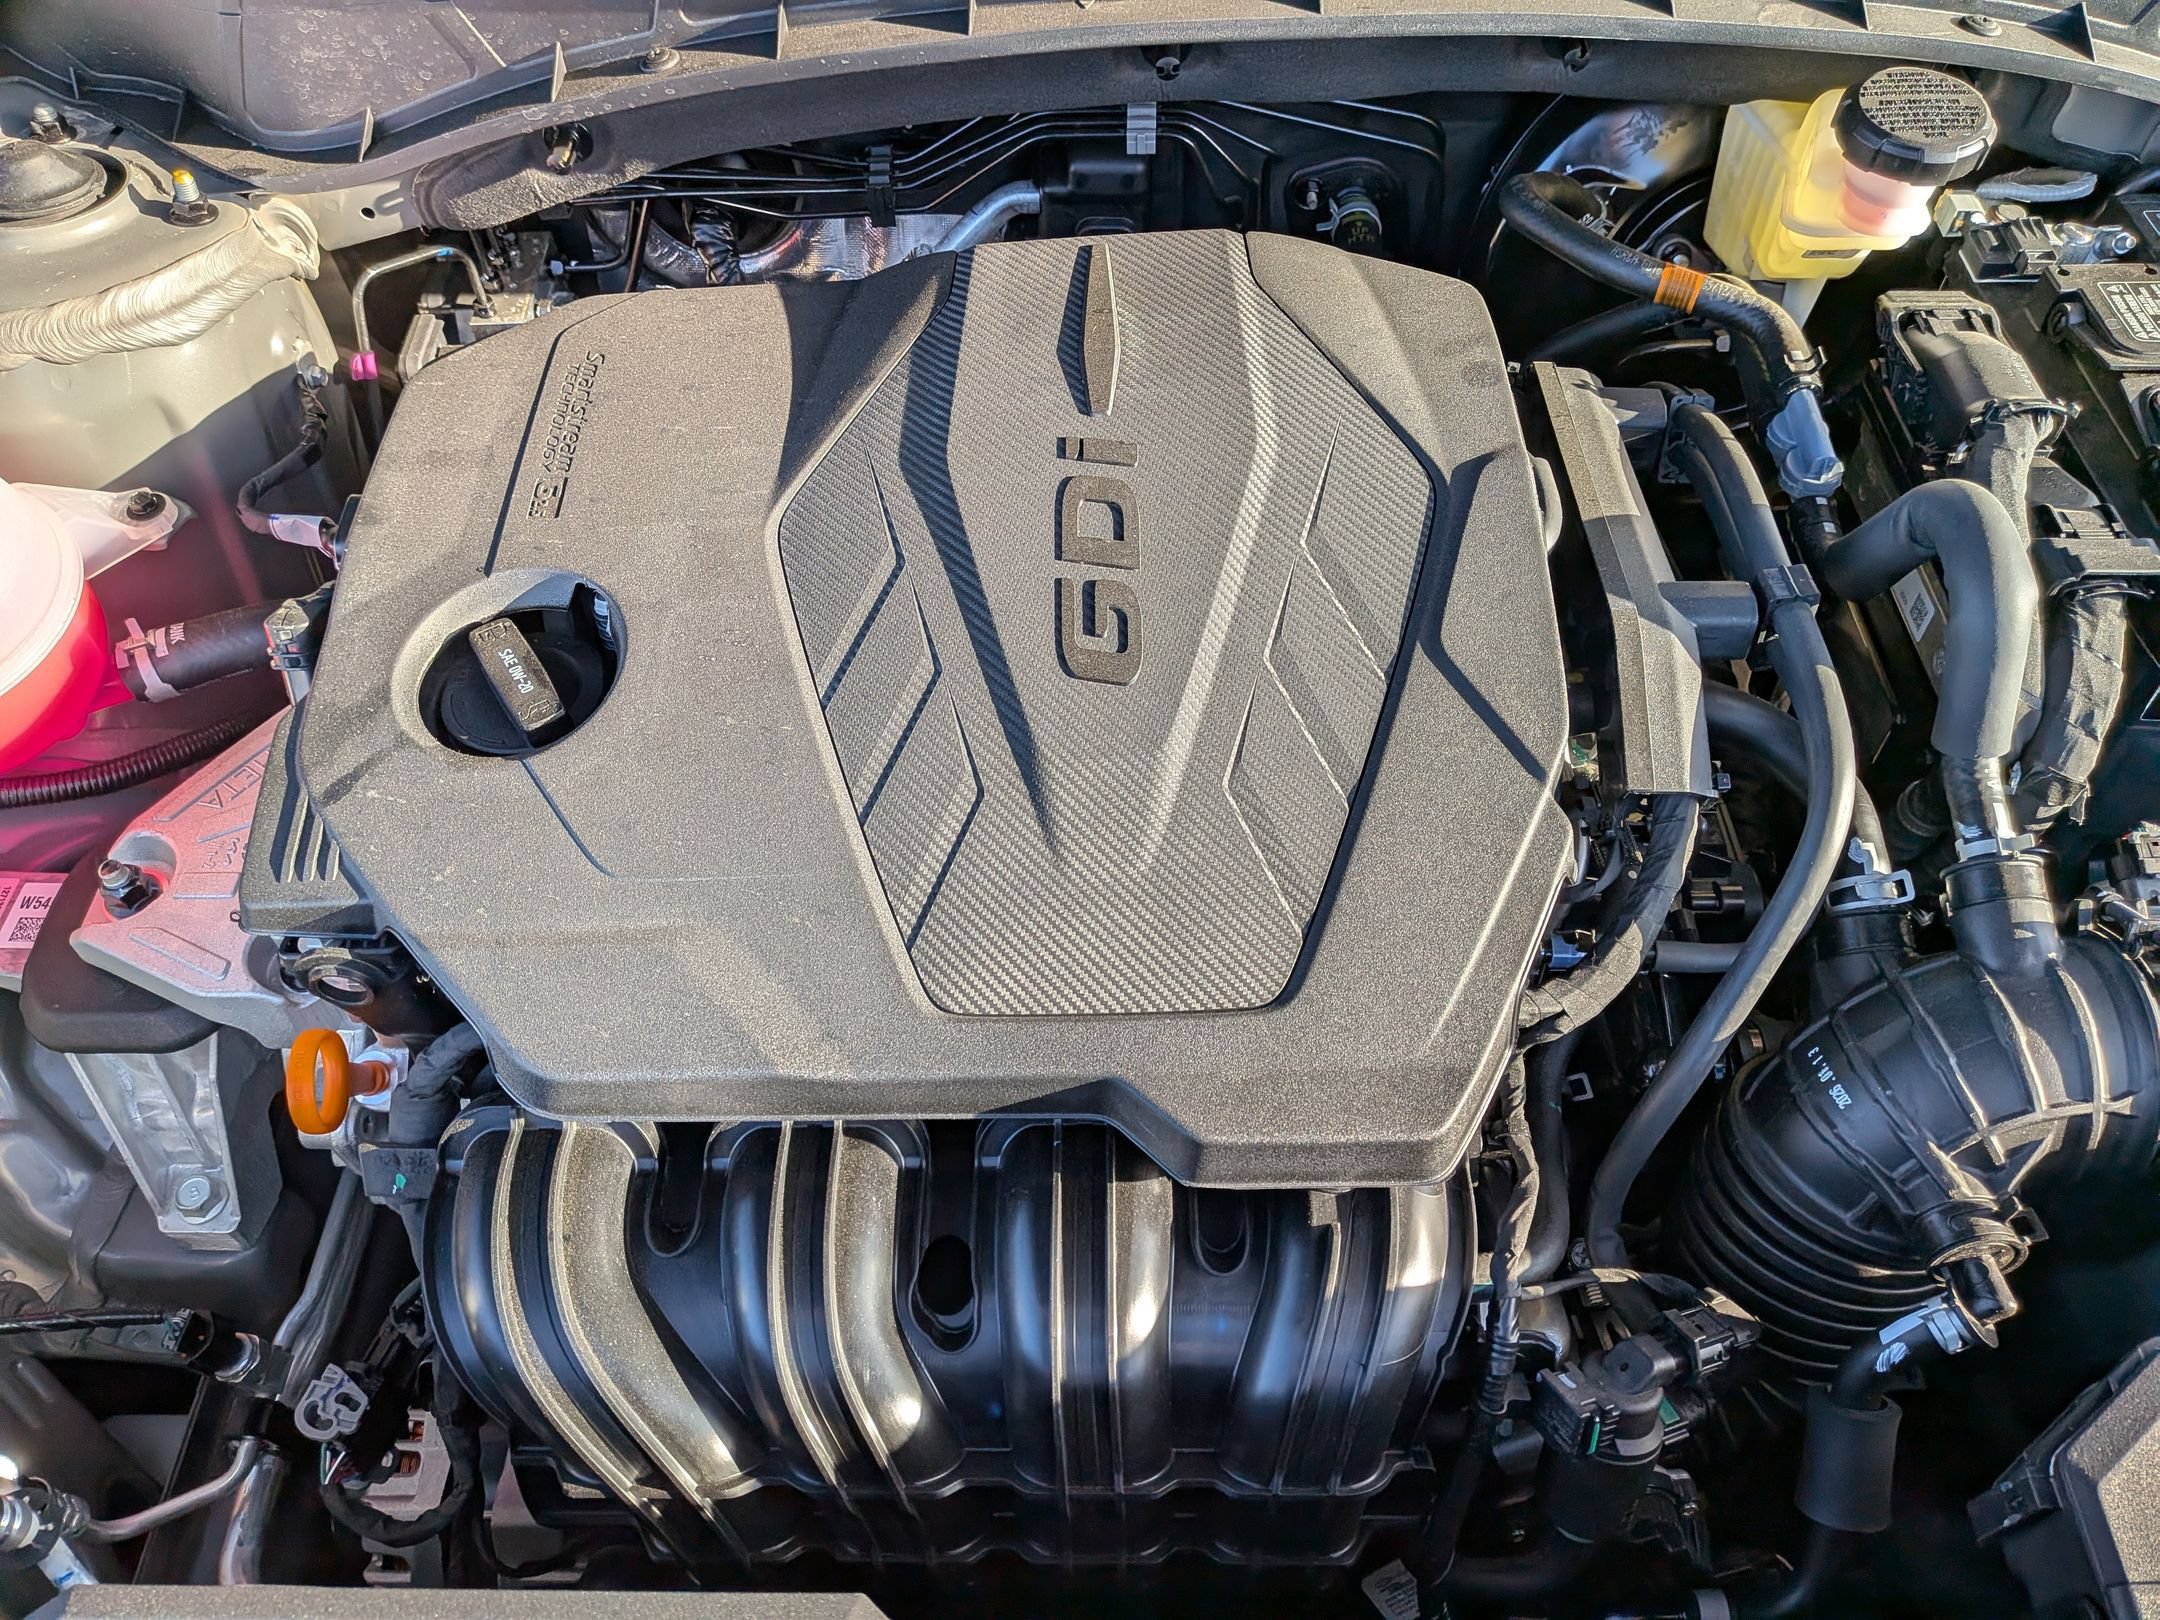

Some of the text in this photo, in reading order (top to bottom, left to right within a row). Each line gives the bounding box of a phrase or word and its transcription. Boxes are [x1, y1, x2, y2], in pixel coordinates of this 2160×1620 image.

[542, 363, 581, 475] TECHNOLOGY
[556, 350, 605, 474] Smartstream
[1056, 436, 1143, 687] GDi
[498, 648, 534, 694] SAE 0W-20
[20, 896, 53, 910] W54
